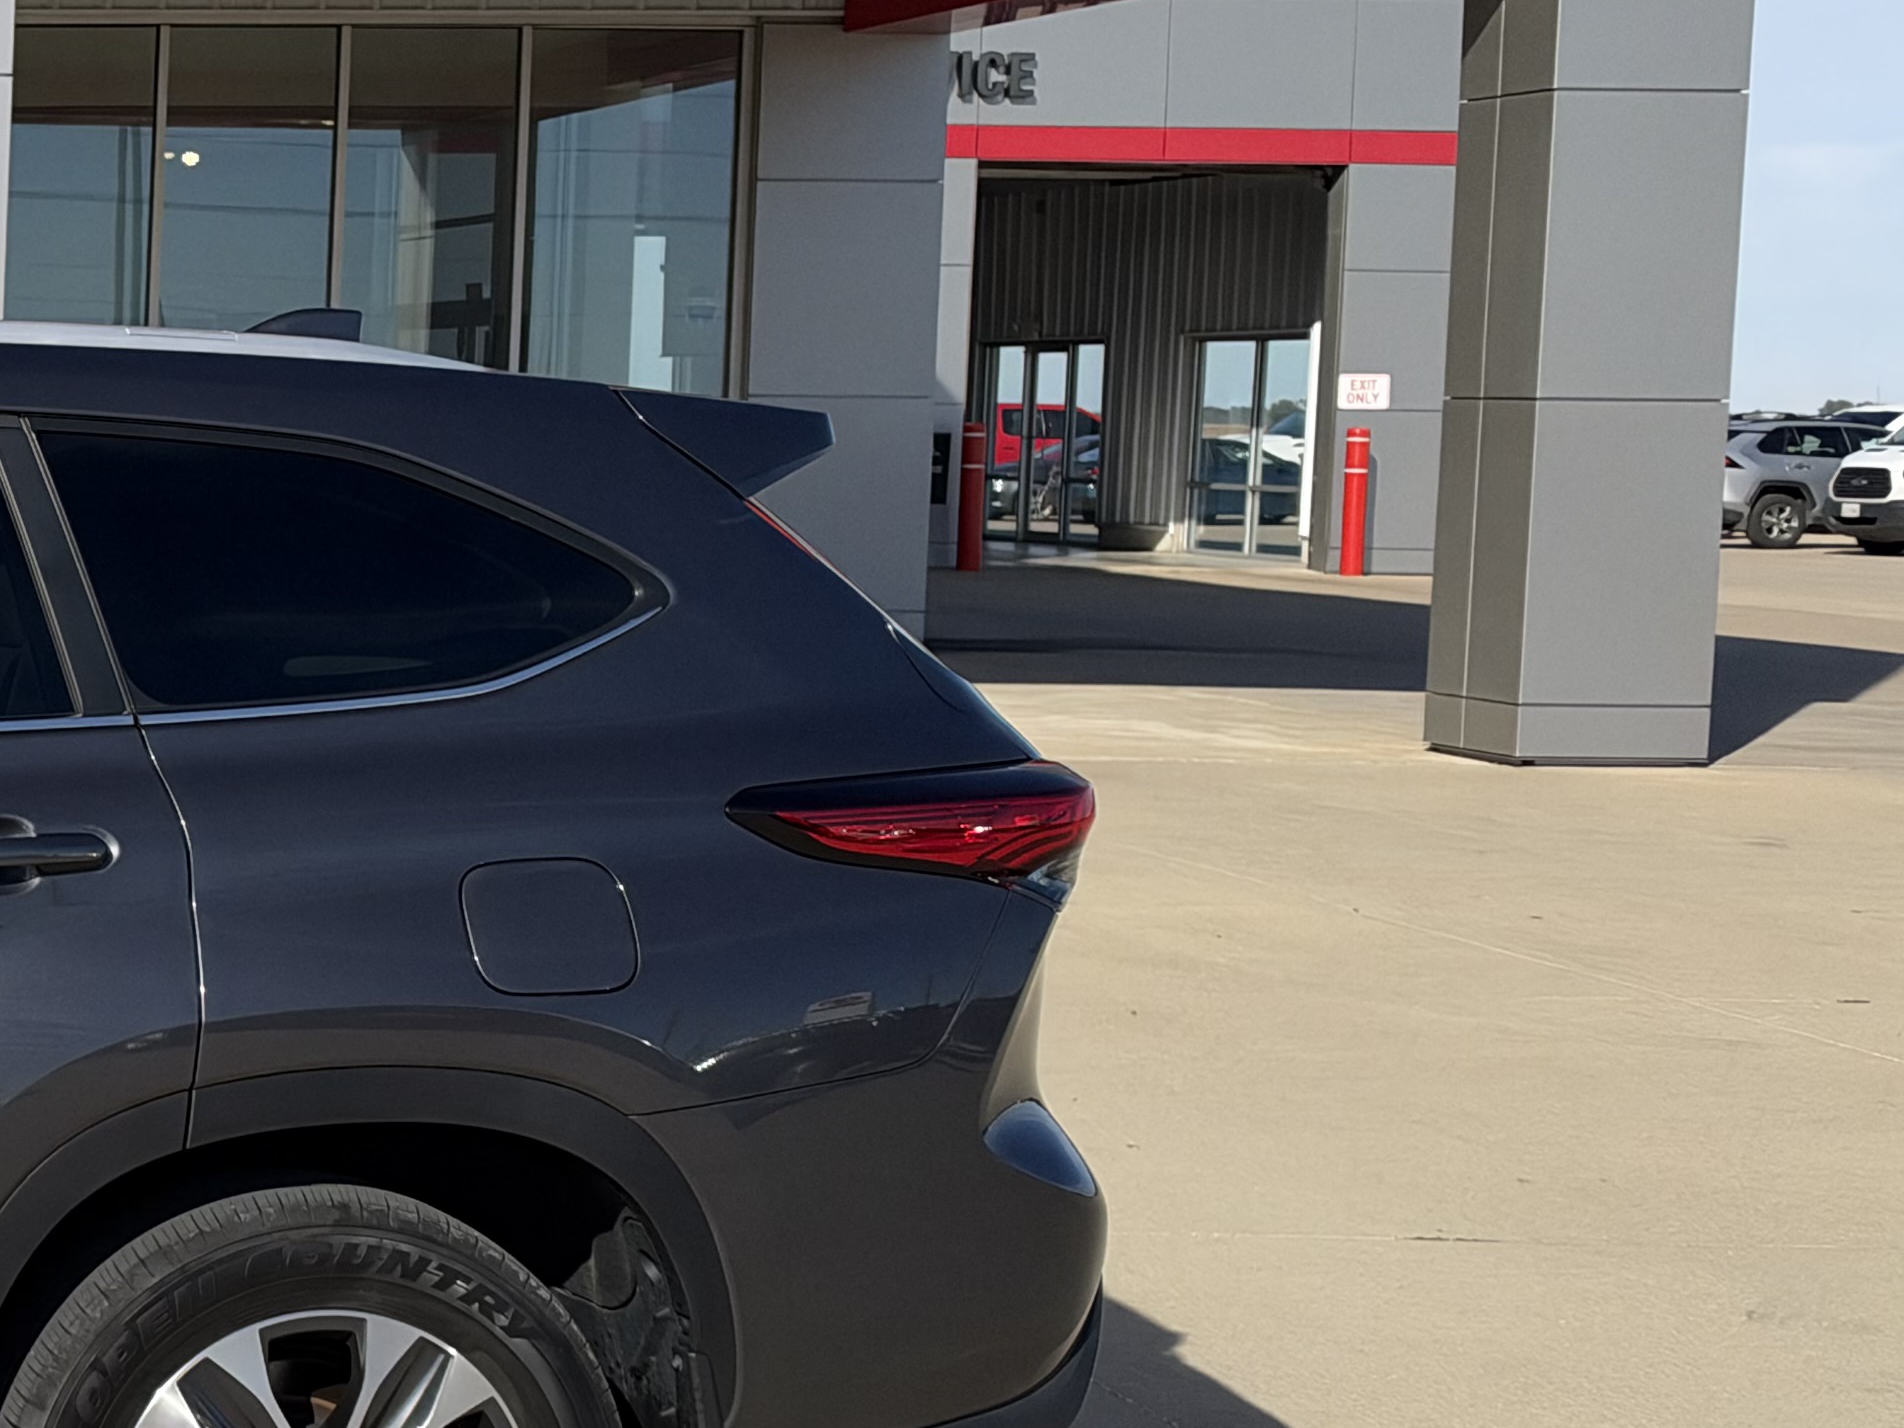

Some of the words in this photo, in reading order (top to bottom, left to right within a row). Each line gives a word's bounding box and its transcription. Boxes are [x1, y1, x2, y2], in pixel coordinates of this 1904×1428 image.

[1350, 378, 1378, 392] EXIT
[1346, 391, 1380, 405] ONLY
[76, 1270, 221, 1426] OPEN
[241, 1243, 540, 1342] COUNTRY
